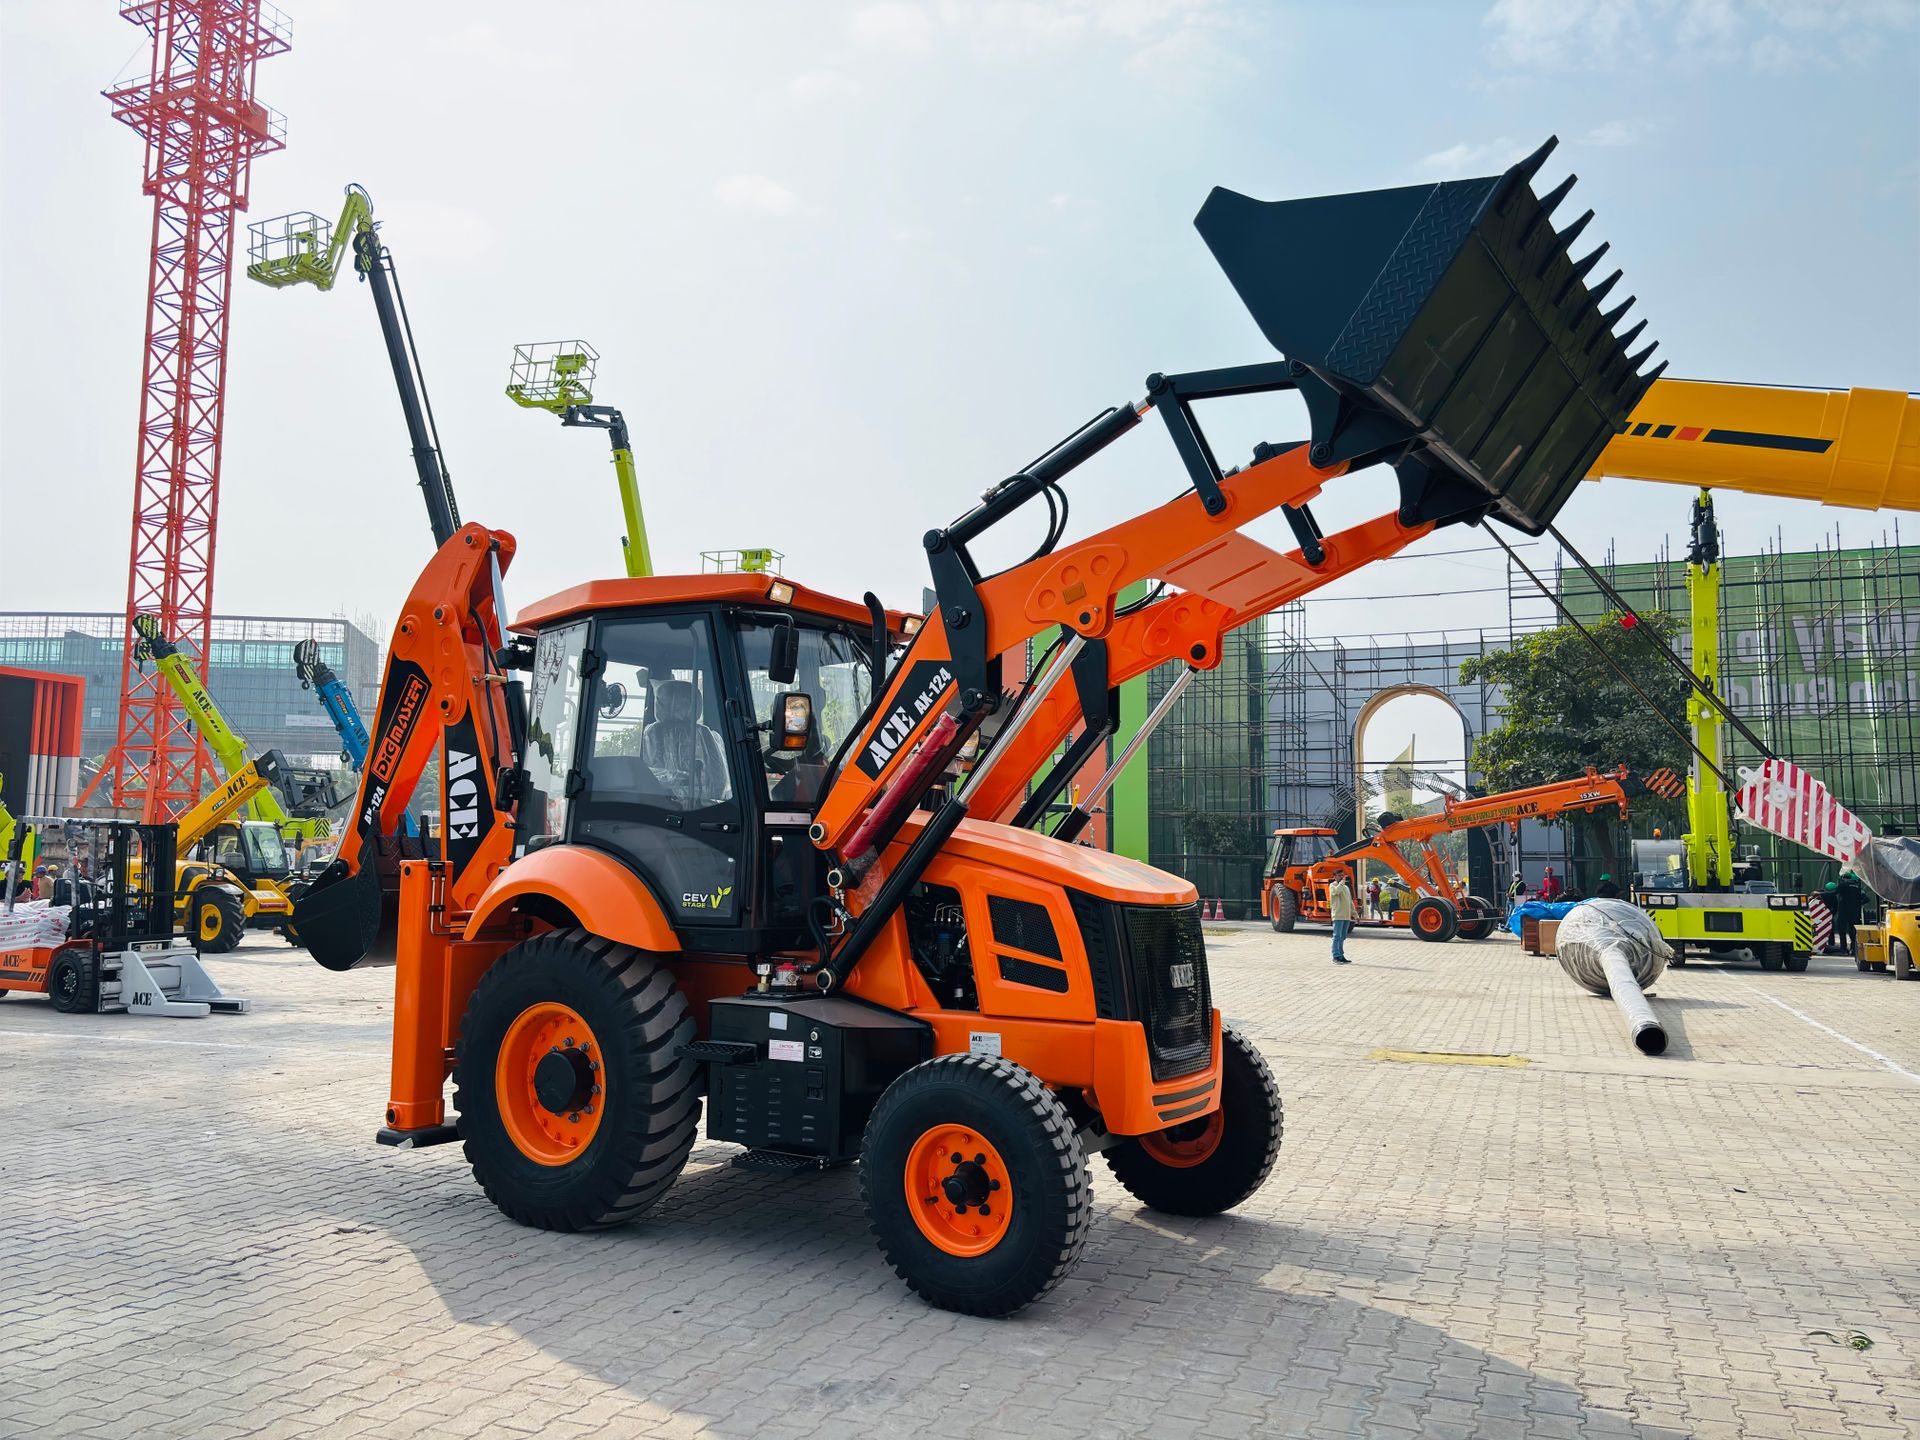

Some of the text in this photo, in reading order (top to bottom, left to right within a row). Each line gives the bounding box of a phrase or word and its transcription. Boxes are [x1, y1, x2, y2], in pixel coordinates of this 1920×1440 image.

[193, 690, 212, 713] ACE
[914, 666, 952, 716] AX-124
[868, 706, 916, 770] ACE
[227, 774, 248, 799] ACE
[448, 749, 479, 840] ACE
[1516, 802, 1539, 815] ACE
[682, 893, 709, 903] CEV
[3, 954, 20, 968] ACE
[132, 991, 152, 1006] ACE
